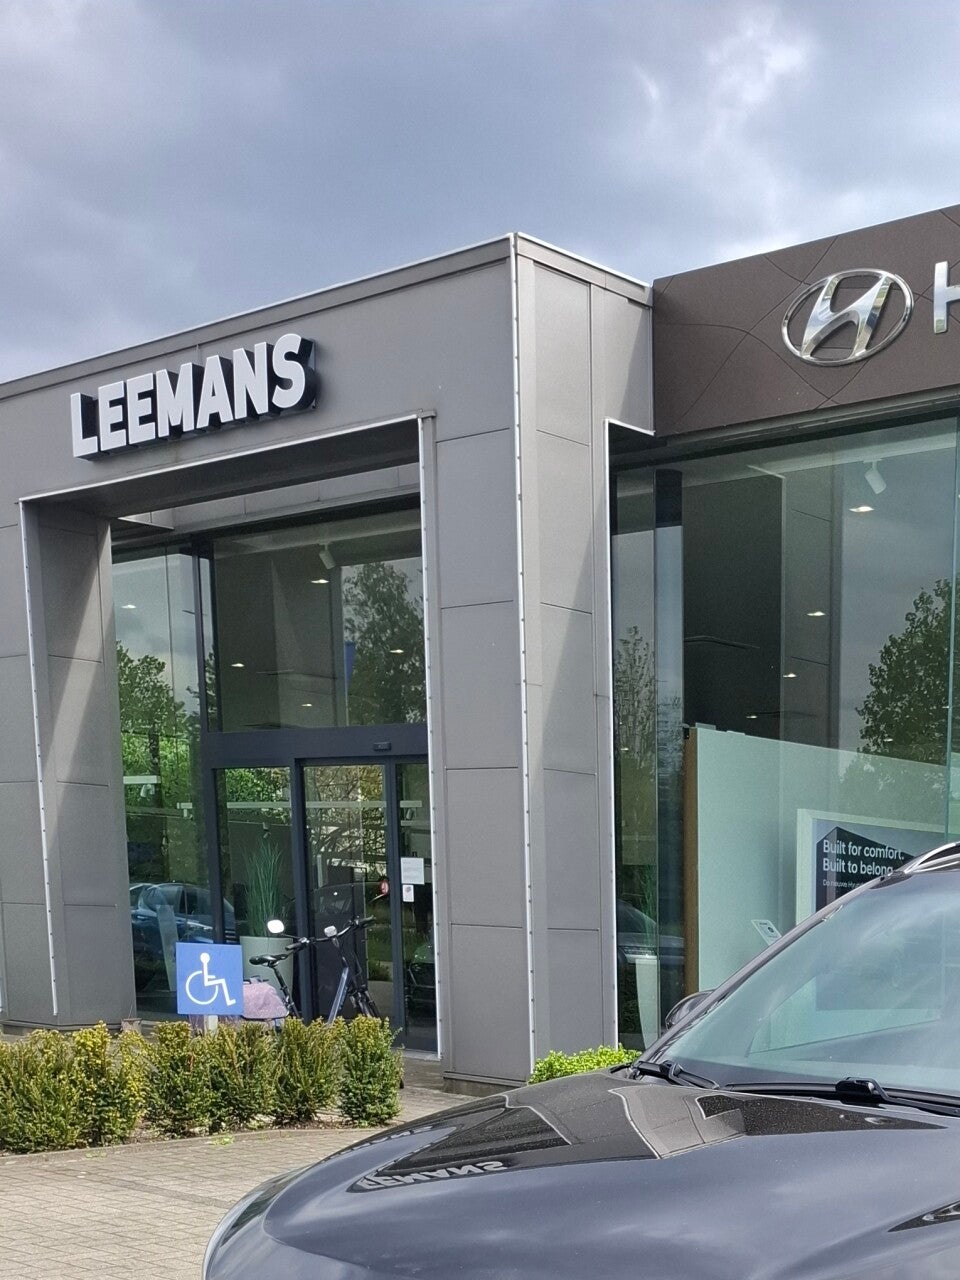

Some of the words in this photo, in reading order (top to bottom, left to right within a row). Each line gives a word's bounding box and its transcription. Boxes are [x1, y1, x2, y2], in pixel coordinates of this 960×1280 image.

[70, 333, 306, 458] LEEMANS
[823, 840, 846, 855] Built
[848, 842, 862, 856] for
[863, 846, 905, 860] comfort.
[823, 858, 846, 874] Built
[847, 860, 858, 874] to
